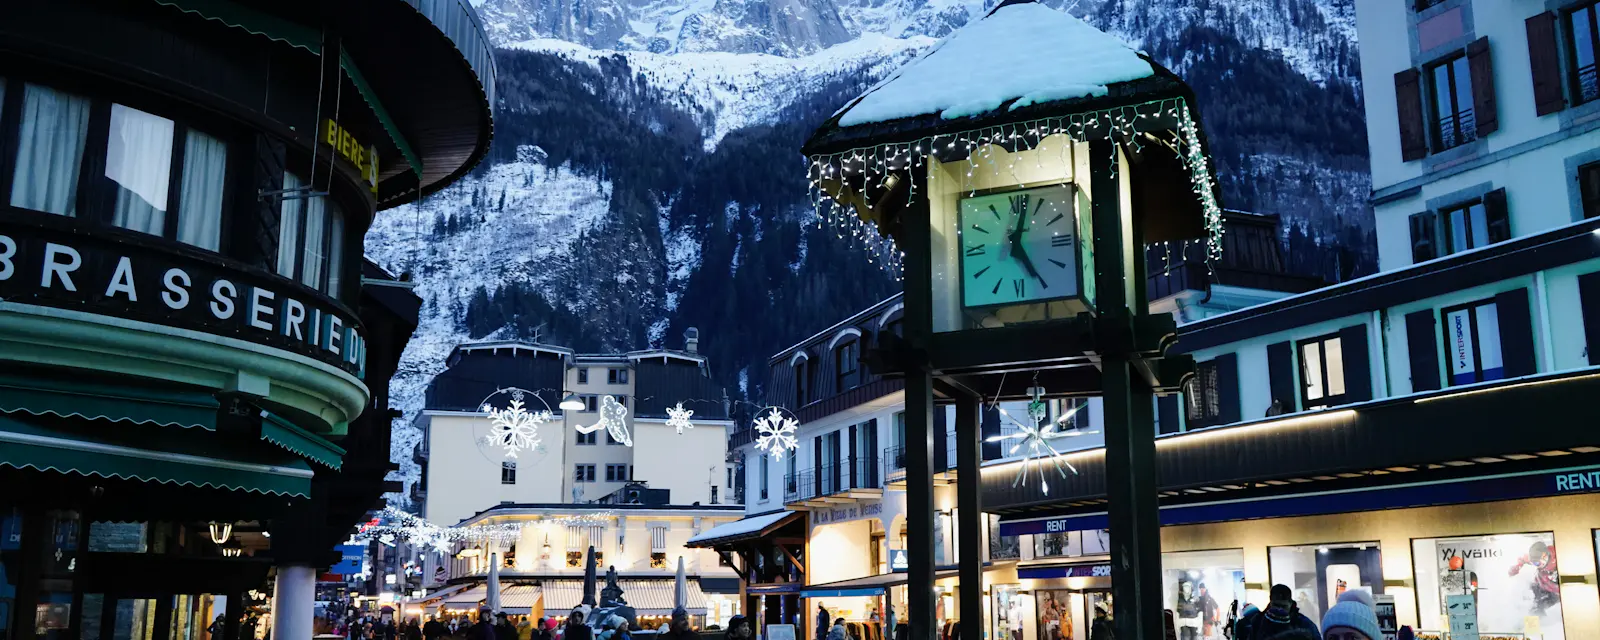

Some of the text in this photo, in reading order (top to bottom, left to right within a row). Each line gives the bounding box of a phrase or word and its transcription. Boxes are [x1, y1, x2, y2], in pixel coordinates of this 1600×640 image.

[0, 235, 366, 374] BRASSERIE DU
[1455, 315, 1466, 360] INTERSPORT
[1556, 471, 1600, 491] RENT
[1046, 520, 1067, 532] RENT
[1073, 565, 1111, 577] INTERSPOR
